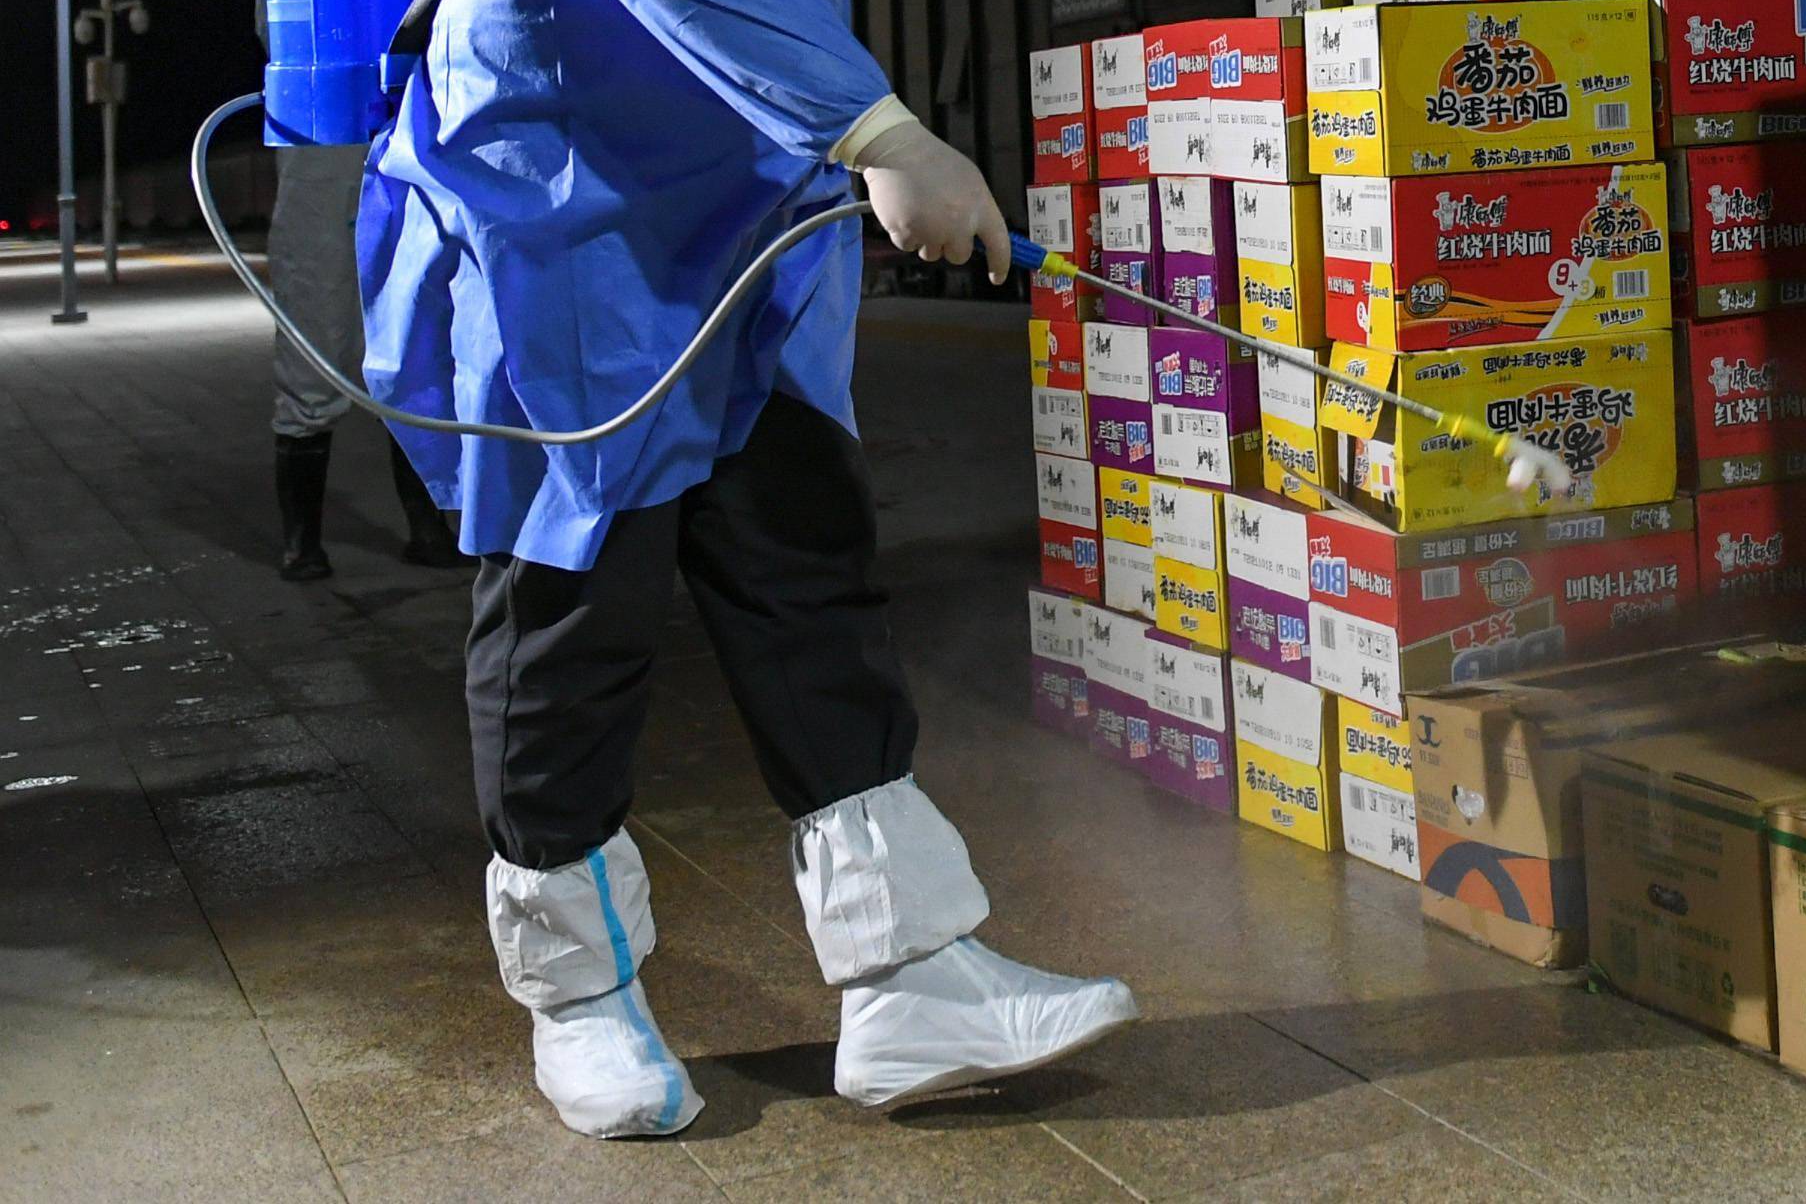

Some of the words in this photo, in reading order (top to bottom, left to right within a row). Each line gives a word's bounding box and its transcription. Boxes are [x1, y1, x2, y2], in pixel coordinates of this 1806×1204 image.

[1147, 51, 1177, 91] BIG
[1210, 48, 1241, 88] BIG
[1453, 42, 1535, 95] 番茄
[1688, 55, 1796, 85] 红烧牛肉面
[1425, 85, 1570, 129] 鸡蛋牛肉面
[1311, 108, 1376, 140] 番茄鸡蛋牛肉面
[1061, 123, 1085, 158] BIG
[1470, 144, 1571, 168] 番茄鸡蛋牛肉面
[1590, 207, 1642, 233] 番茄
[1436, 229, 1552, 261] 红烧牛肉面
[1571, 231, 1663, 258] 鸡蛋牛肉面
[1410, 281, 1446, 304] 经典
[1482, 346, 1587, 372] 番茄鸡蛋牛肉面
[1159, 370, 1182, 395] BIG
[1487, 389, 1634, 431] 鸡蛋牛肉面
[1126, 421, 1148, 445] BIG
[1073, 536, 1097, 569] BIG
[1311, 556, 1348, 598] BIG
[1278, 614, 1305, 643] BIG
